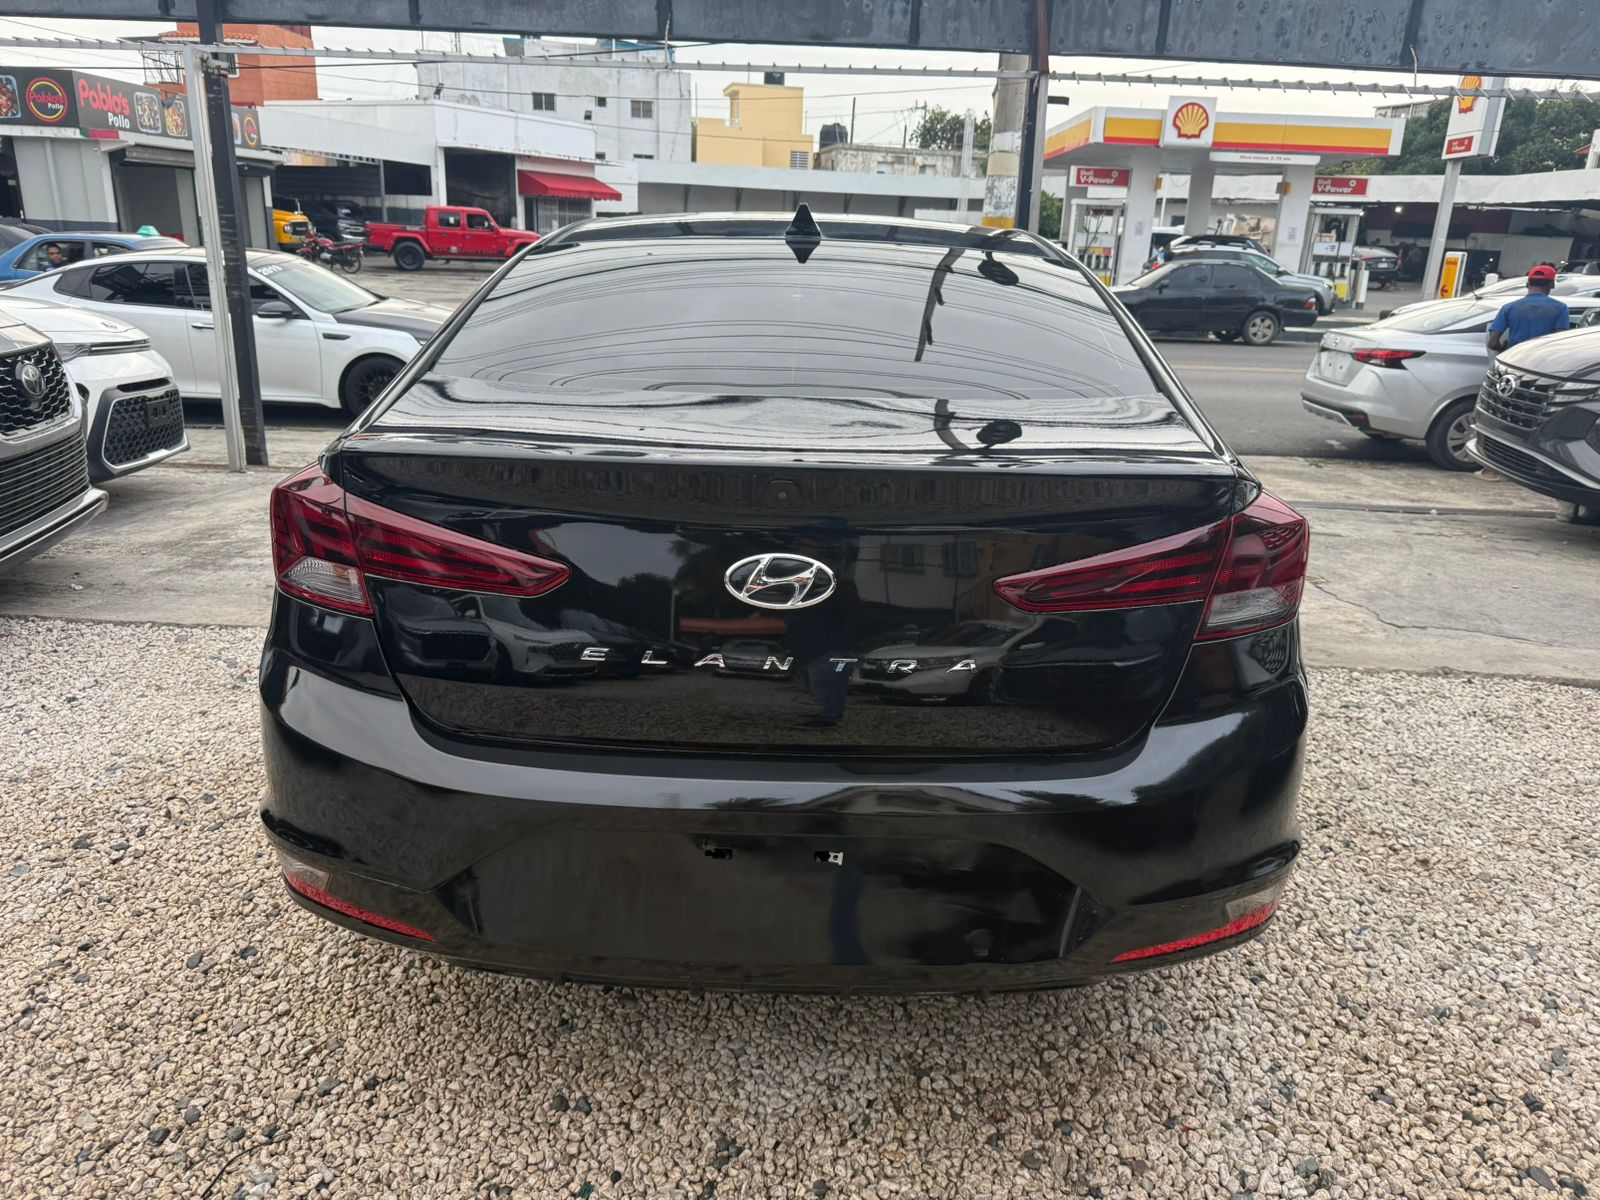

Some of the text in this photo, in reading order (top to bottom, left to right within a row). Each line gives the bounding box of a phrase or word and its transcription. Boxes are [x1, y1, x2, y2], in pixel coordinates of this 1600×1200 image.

[79, 79, 130, 116] Pablo's
[48, 102, 64, 110] Pollo
[108, 112, 130, 129] Pollo
[1080, 175, 1115, 184] V-Power
[1317, 184, 1353, 193] V-Power
[580, 647, 978, 674] ELANTRA
